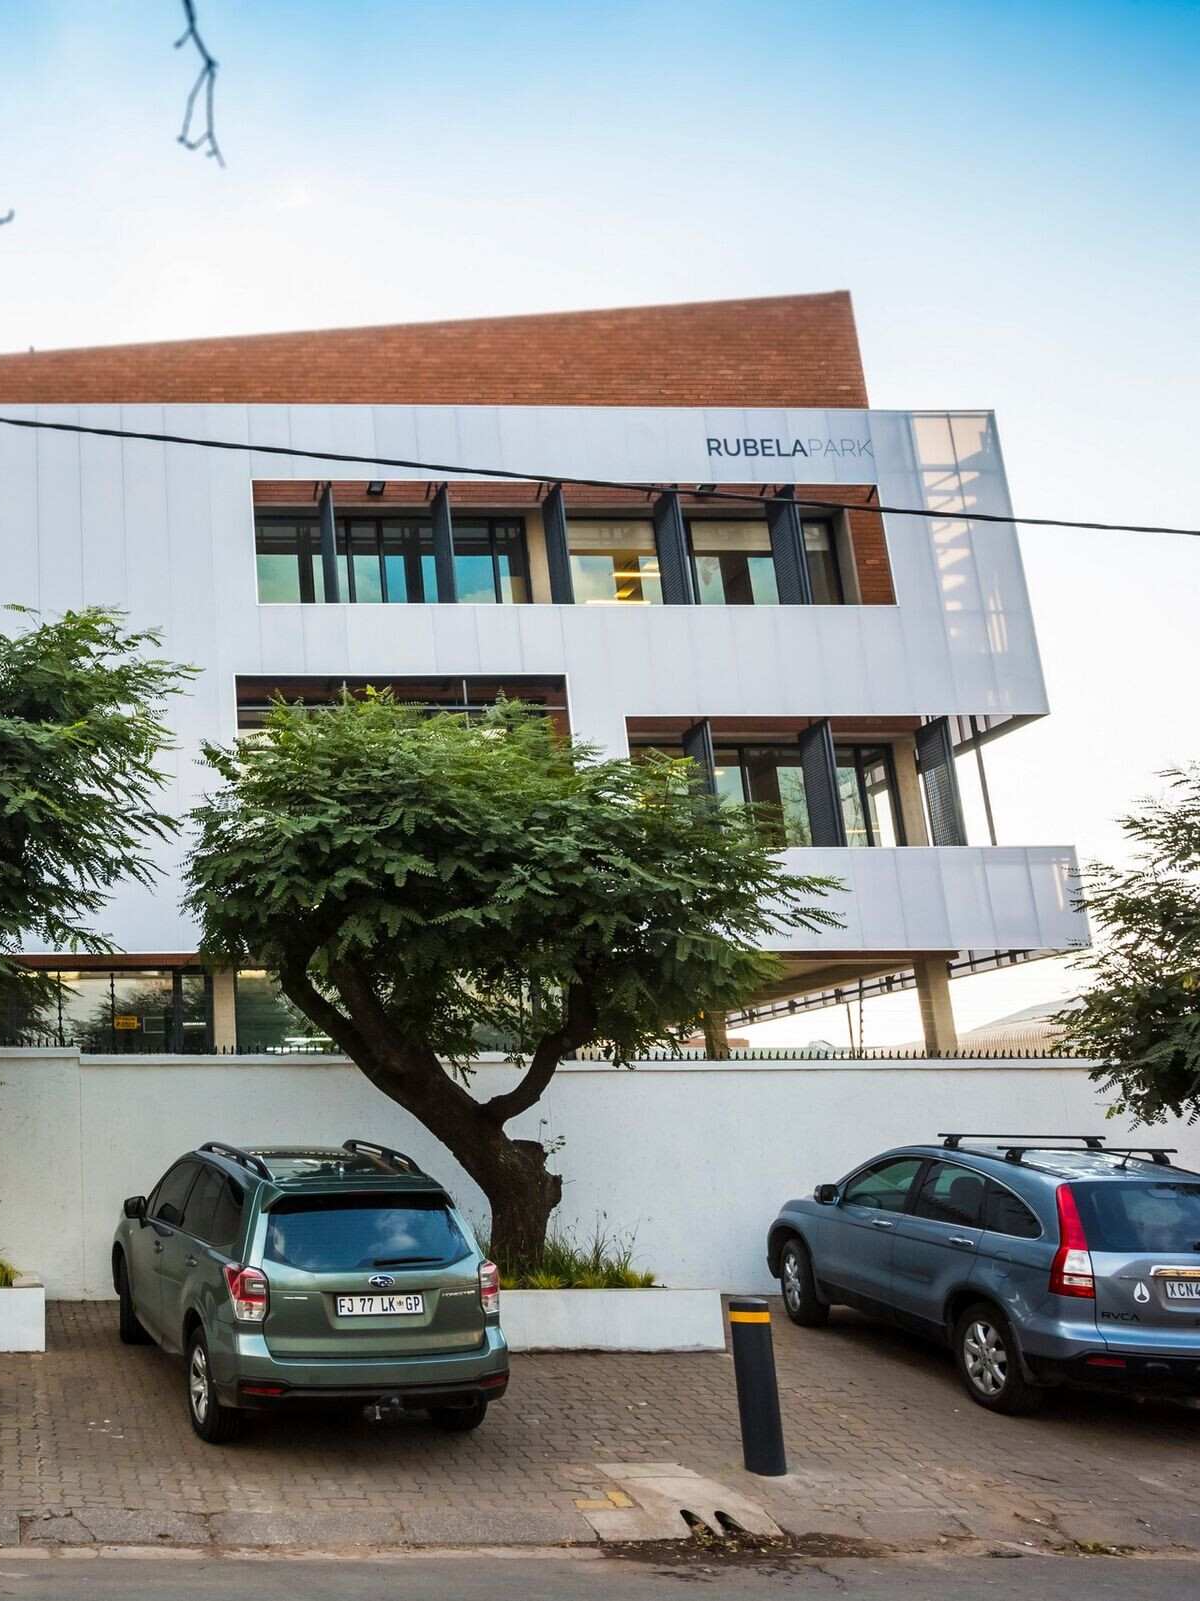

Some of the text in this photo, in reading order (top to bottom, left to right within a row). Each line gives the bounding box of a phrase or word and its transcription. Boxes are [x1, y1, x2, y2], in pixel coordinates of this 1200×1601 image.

[339, 1296, 420, 1313] FJ 77 LK GP
[1101, 1311, 1140, 1321] RVCA
